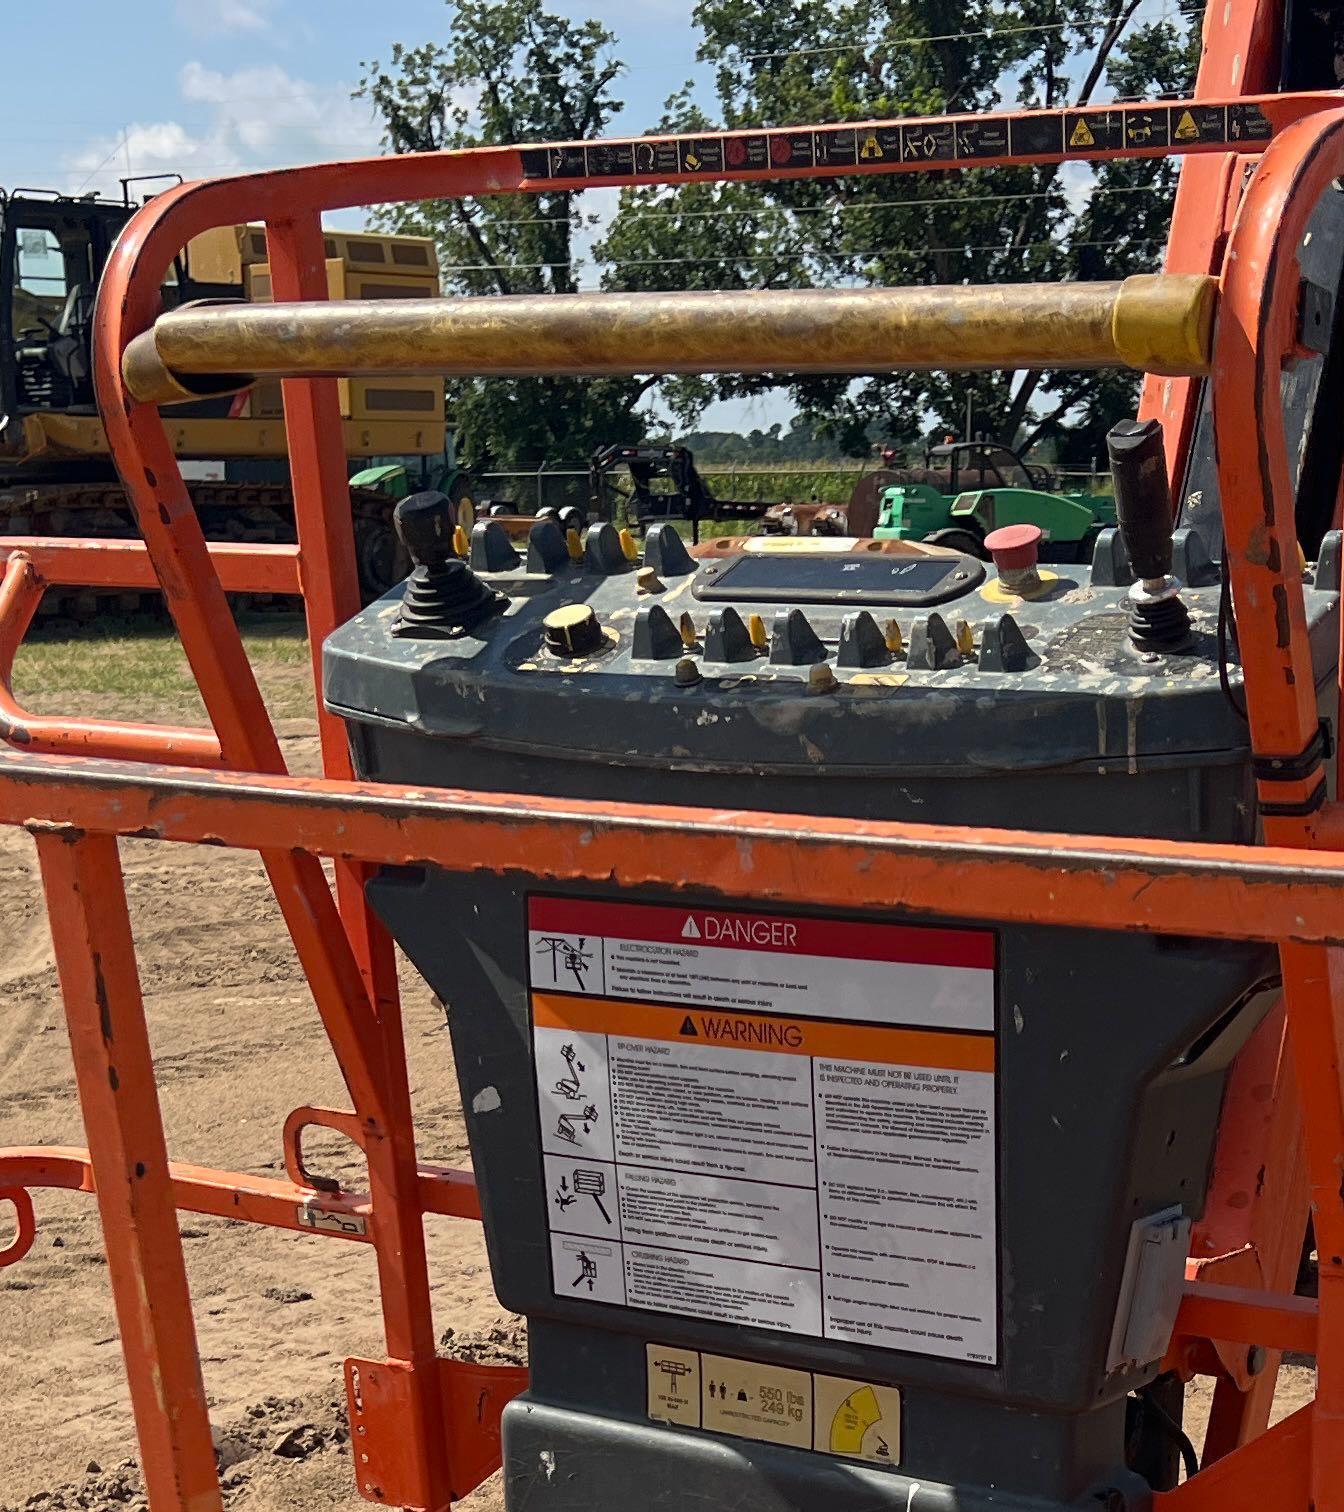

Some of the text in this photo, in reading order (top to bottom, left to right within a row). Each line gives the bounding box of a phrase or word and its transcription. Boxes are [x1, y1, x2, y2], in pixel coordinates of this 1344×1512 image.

[704, 916, 798, 948] DANGER
[701, 1016, 804, 1048] WARNING
[759, 1385, 783, 1402] 550
[760, 1399, 804, 1421] 249 kg
